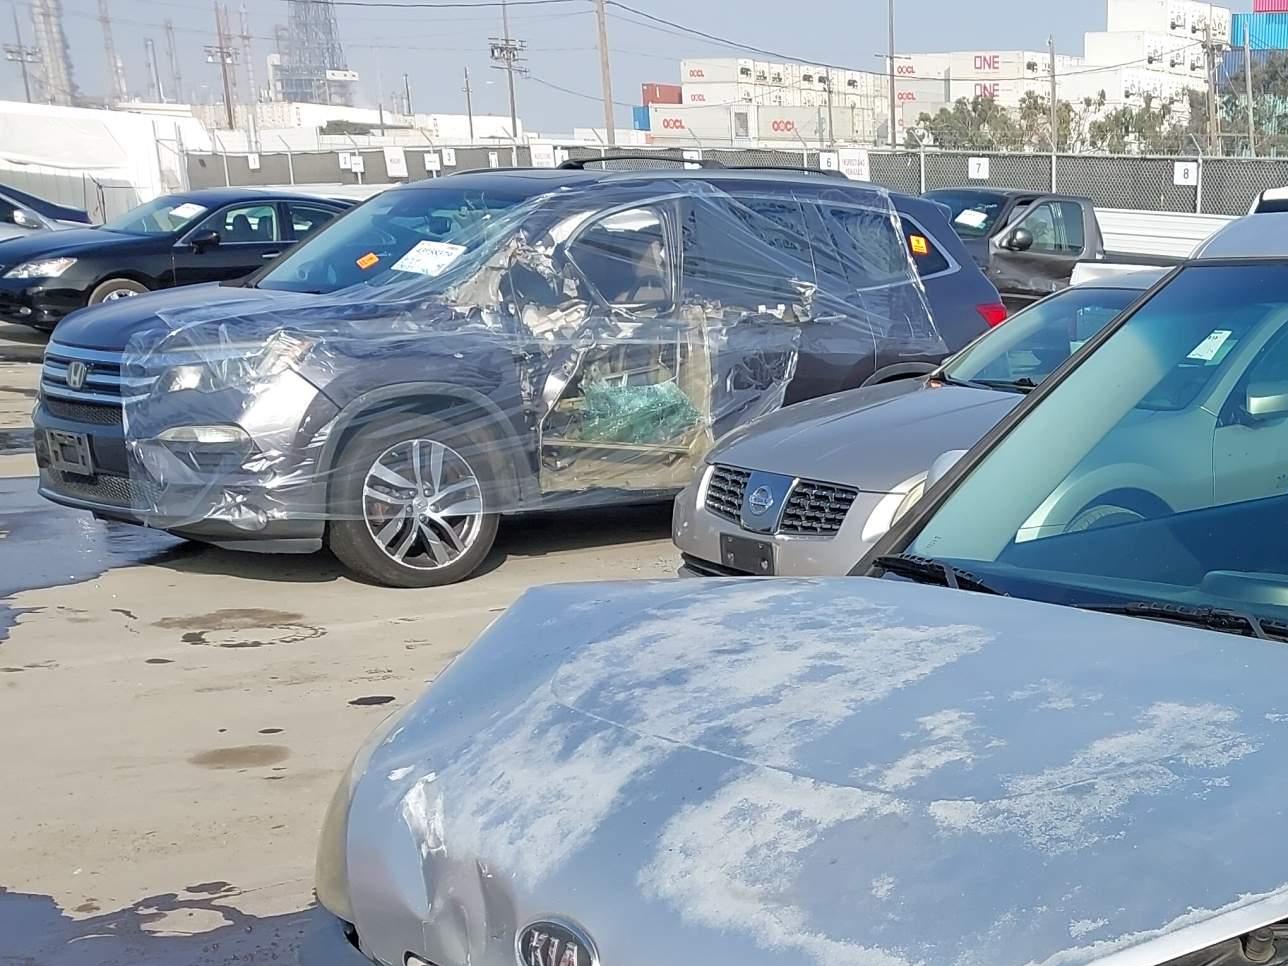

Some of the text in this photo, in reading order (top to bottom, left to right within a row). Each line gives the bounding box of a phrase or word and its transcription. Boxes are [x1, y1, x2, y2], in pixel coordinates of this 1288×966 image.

[974, 55, 1000, 70] ONE
[689, 69, 705, 78] OOCL
[897, 65, 916, 74] OOCL
[974, 83, 1000, 97] ONE
[897, 92, 917, 100] OOCL
[662, 118, 686, 129] OOCL
[826, 157, 832, 168] 6
[975, 162, 982, 174] 7
[1183, 168, 1190, 179] 8
